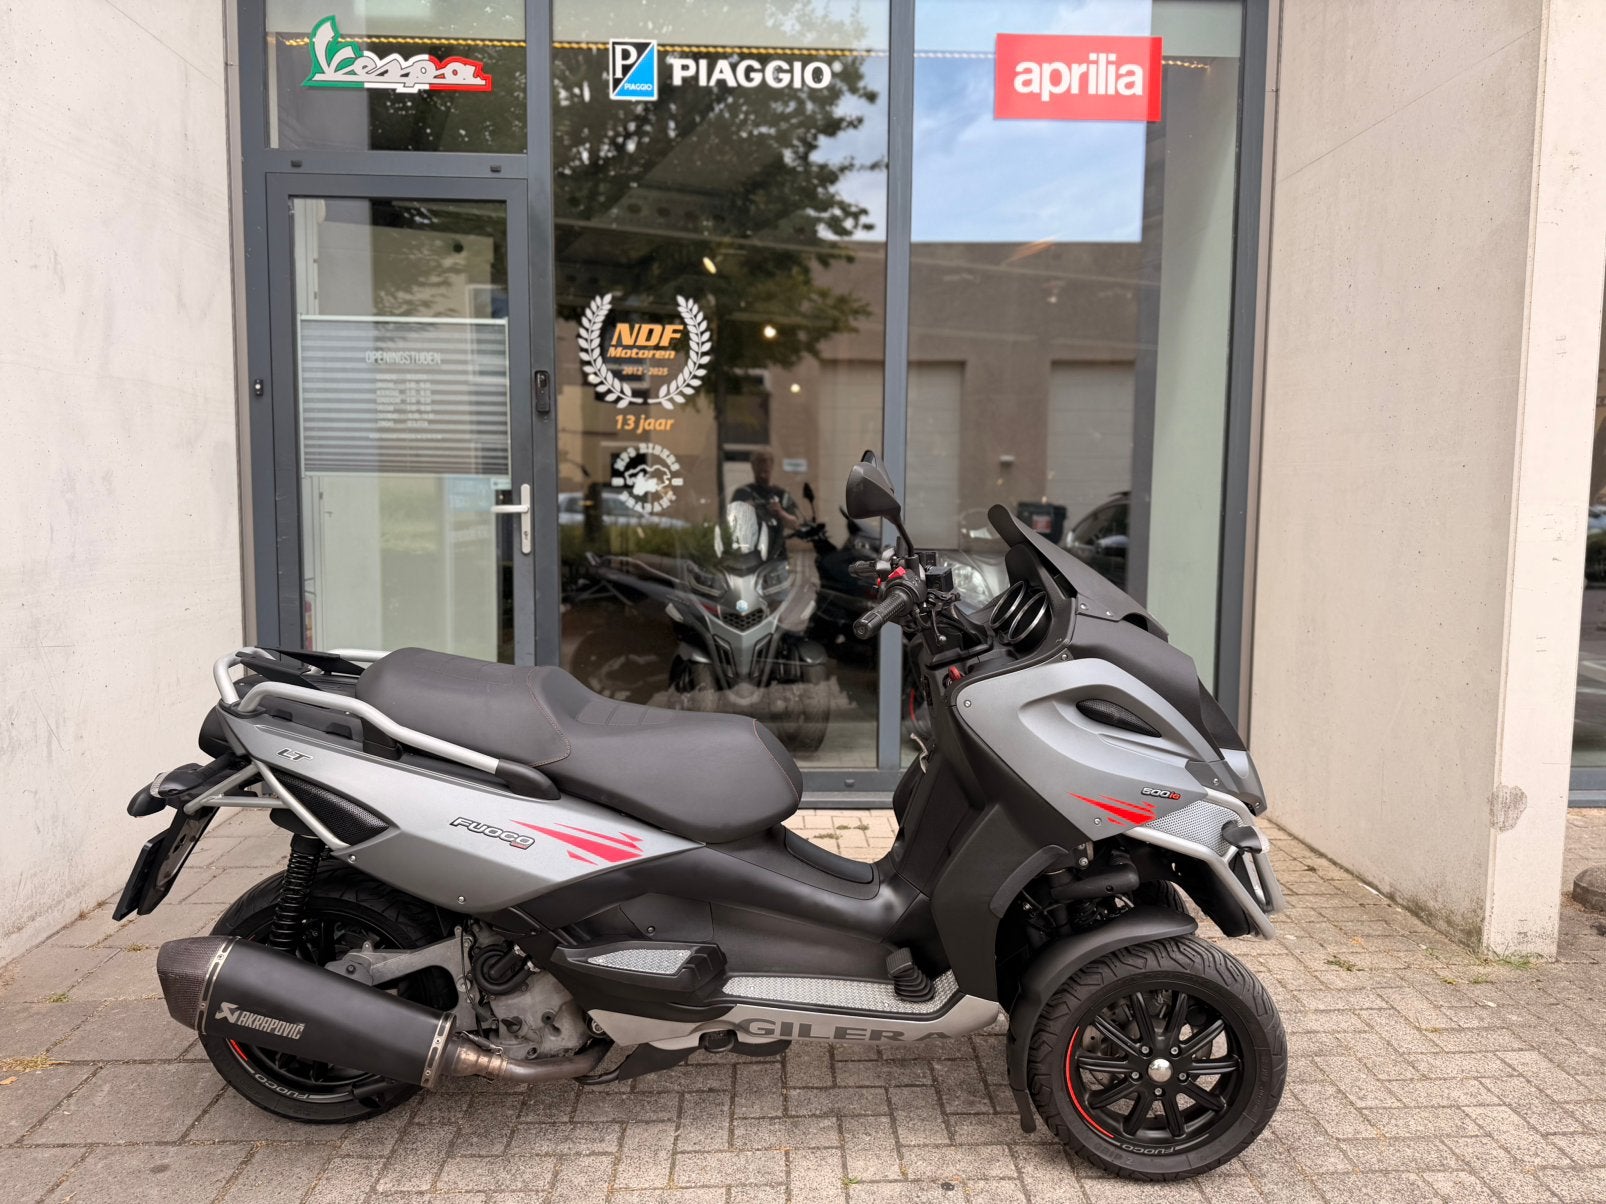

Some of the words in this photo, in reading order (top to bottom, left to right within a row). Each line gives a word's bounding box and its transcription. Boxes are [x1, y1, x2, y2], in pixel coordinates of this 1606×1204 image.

[311, 19, 488, 89] Vespa
[613, 44, 638, 78] P
[671, 57, 832, 89] PIAGGIO
[1013, 52, 1144, 102] aprilia
[624, 83, 653, 91] PIAGGIO
[610, 323, 684, 347] NDF
[607, 347, 676, 360] Motoren
[616, 414, 636, 430] 13
[636, 414, 675, 434] jaar
[276, 747, 314, 762] LT
[449, 817, 536, 849] FUOCO
[736, 1017, 952, 1042] GILERA
[255, 1073, 311, 1100] FUOCO
[1121, 1144, 1175, 1155] FUOCO
